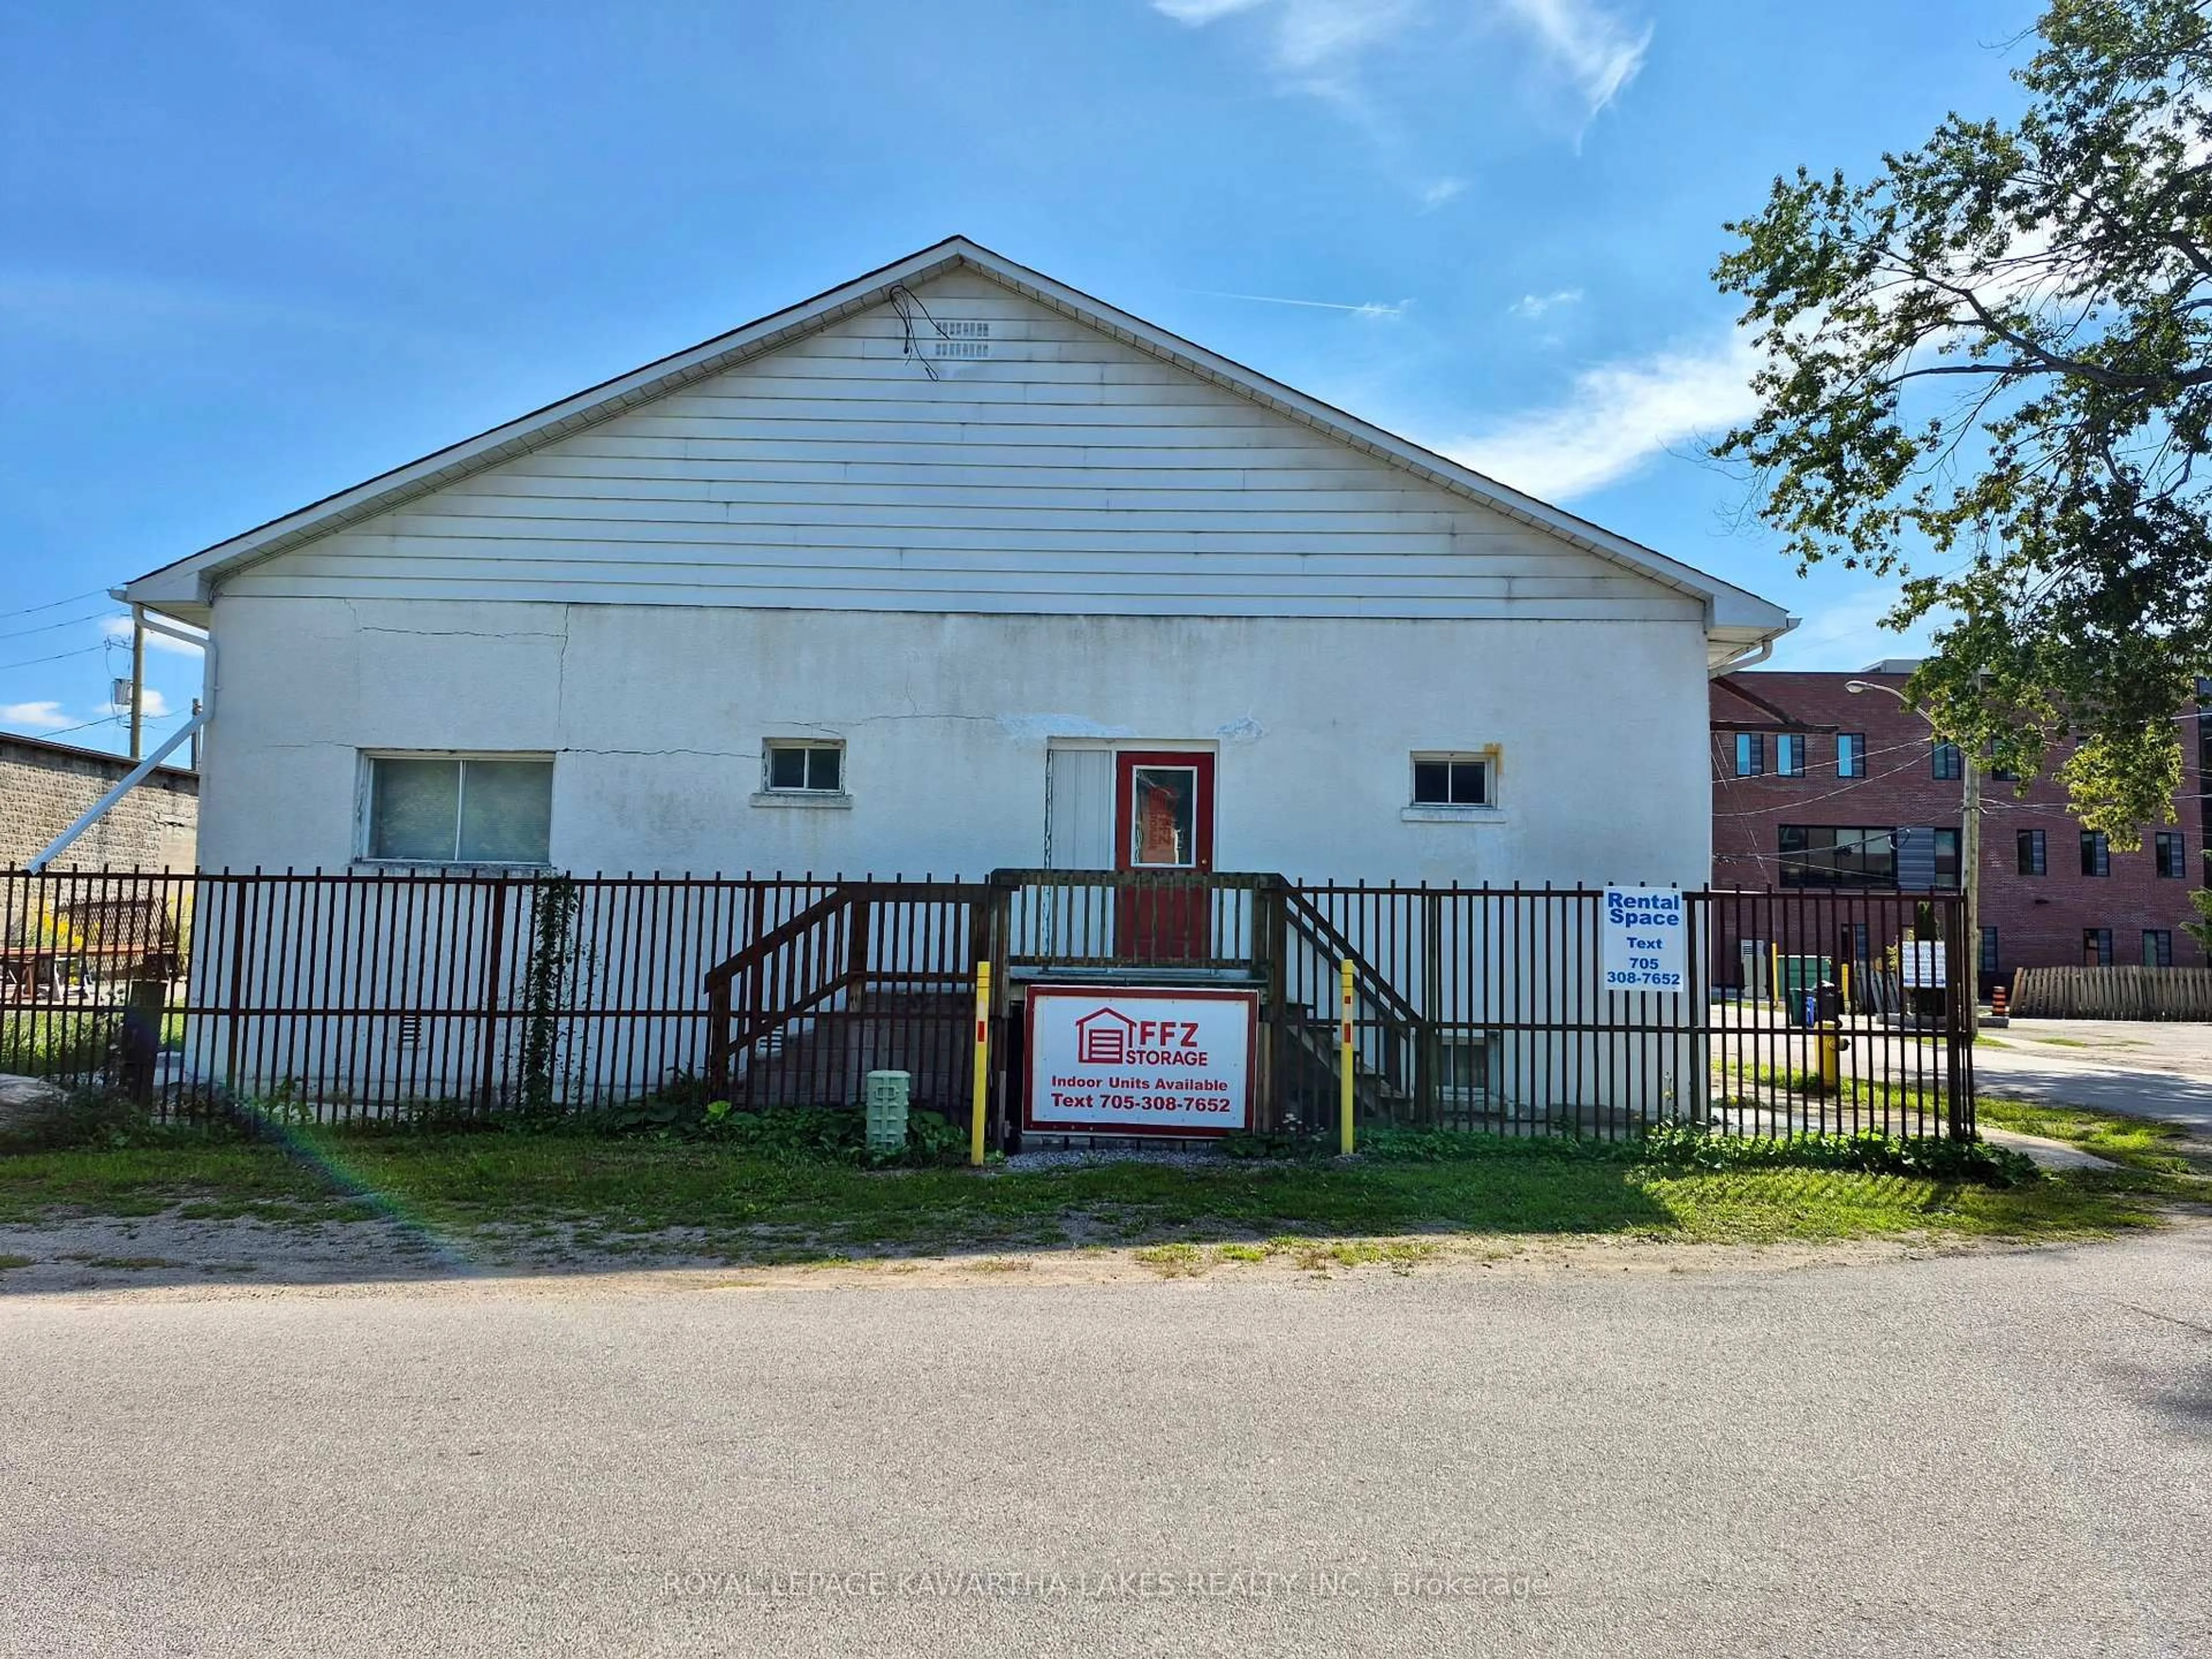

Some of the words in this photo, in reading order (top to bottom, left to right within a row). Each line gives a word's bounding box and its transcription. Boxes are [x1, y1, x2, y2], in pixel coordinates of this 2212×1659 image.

[1608, 892, 1679, 910] Rental
[1609, 908, 1679, 927] Space
[1627, 937, 1662, 949] Text
[1630, 958, 1659, 969] 705
[1607, 971, 1680, 985] 308-7652
[1139, 1021, 1199, 1047] FFZ
[1126, 1050, 1209, 1066] STORAGE
[1051, 1075, 1103, 1088] Indoor
[1109, 1077, 1150, 1090] Units
[1155, 1078, 1228, 1092] Available
[1051, 1093, 1093, 1108] Text
[1100, 1095, 1230, 1112] 705-308-7652
